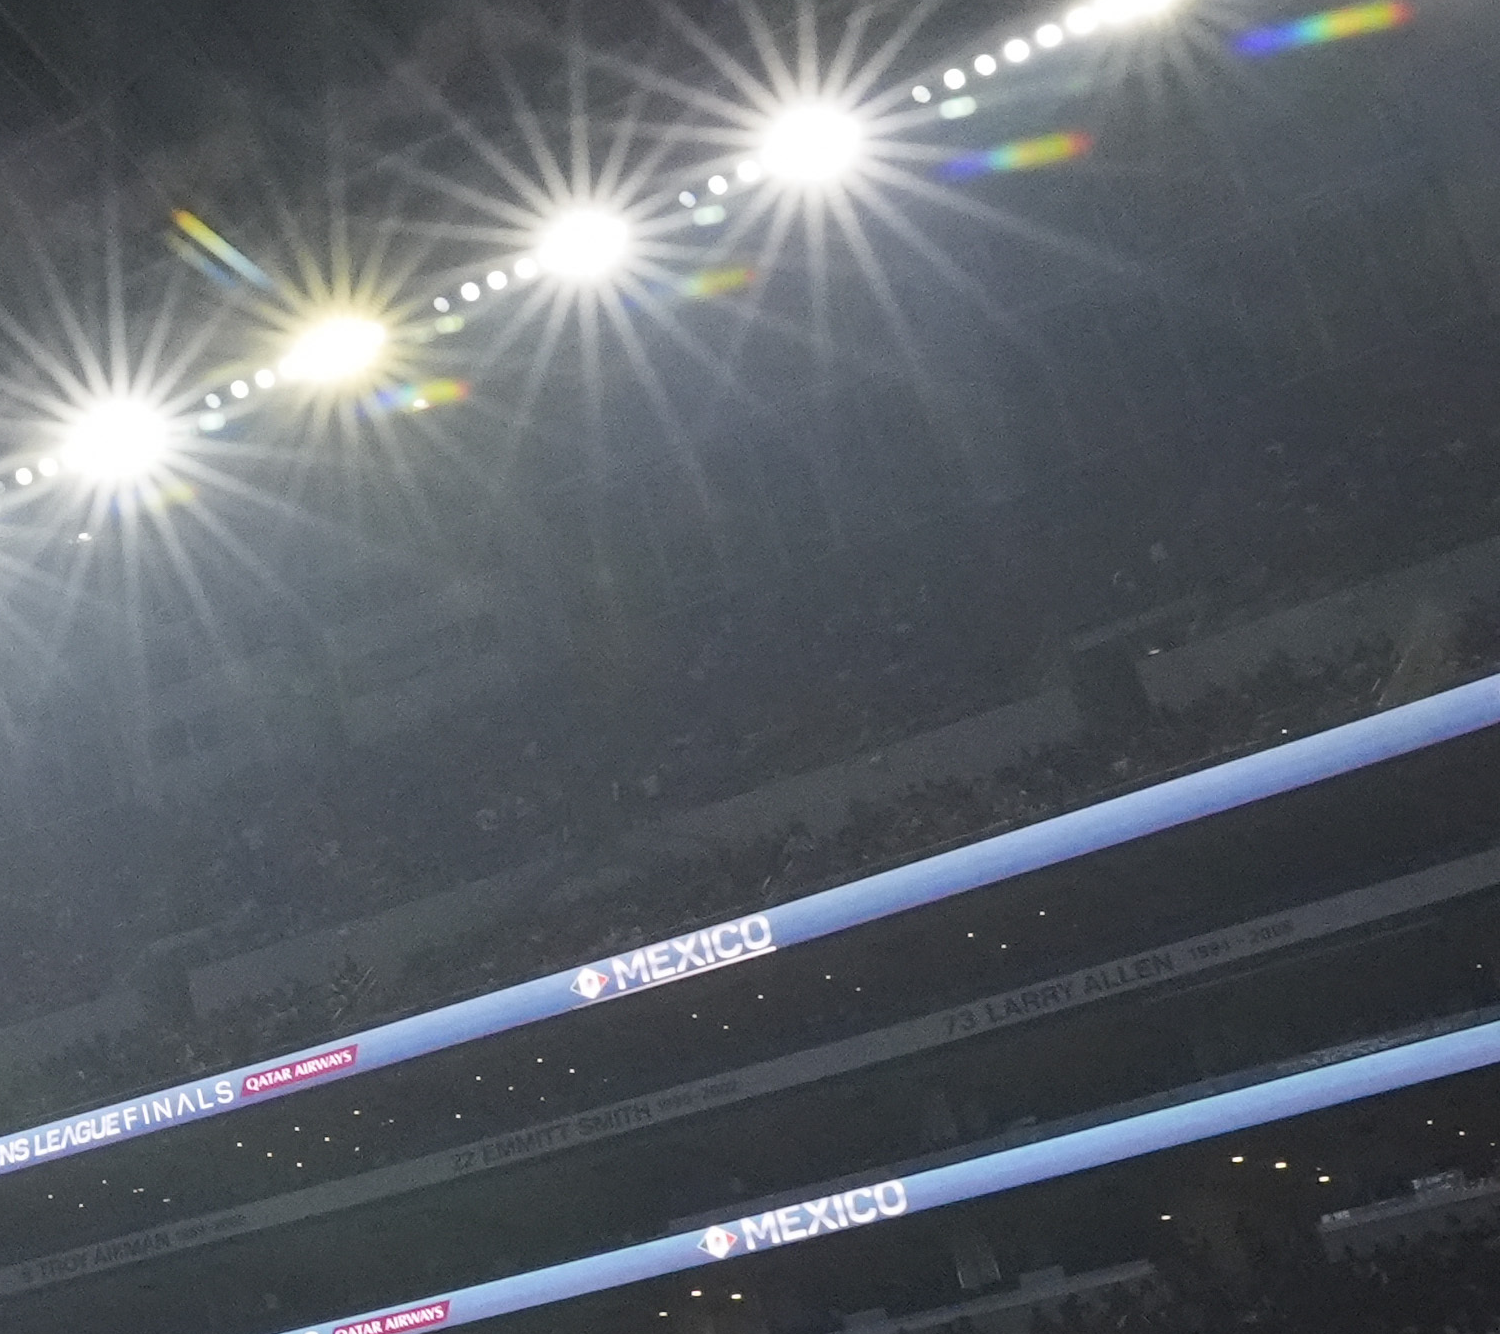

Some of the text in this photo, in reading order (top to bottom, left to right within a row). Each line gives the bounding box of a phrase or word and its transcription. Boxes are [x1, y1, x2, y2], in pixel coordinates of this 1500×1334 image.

[611, 913, 772, 990] MEXICO
[33, 1112, 120, 1156] LEAGUE
[123, 1080, 234, 1131] FINALS
[246, 1067, 293, 1091] QATAR
[294, 1050, 352, 1078] AIRWAYS
